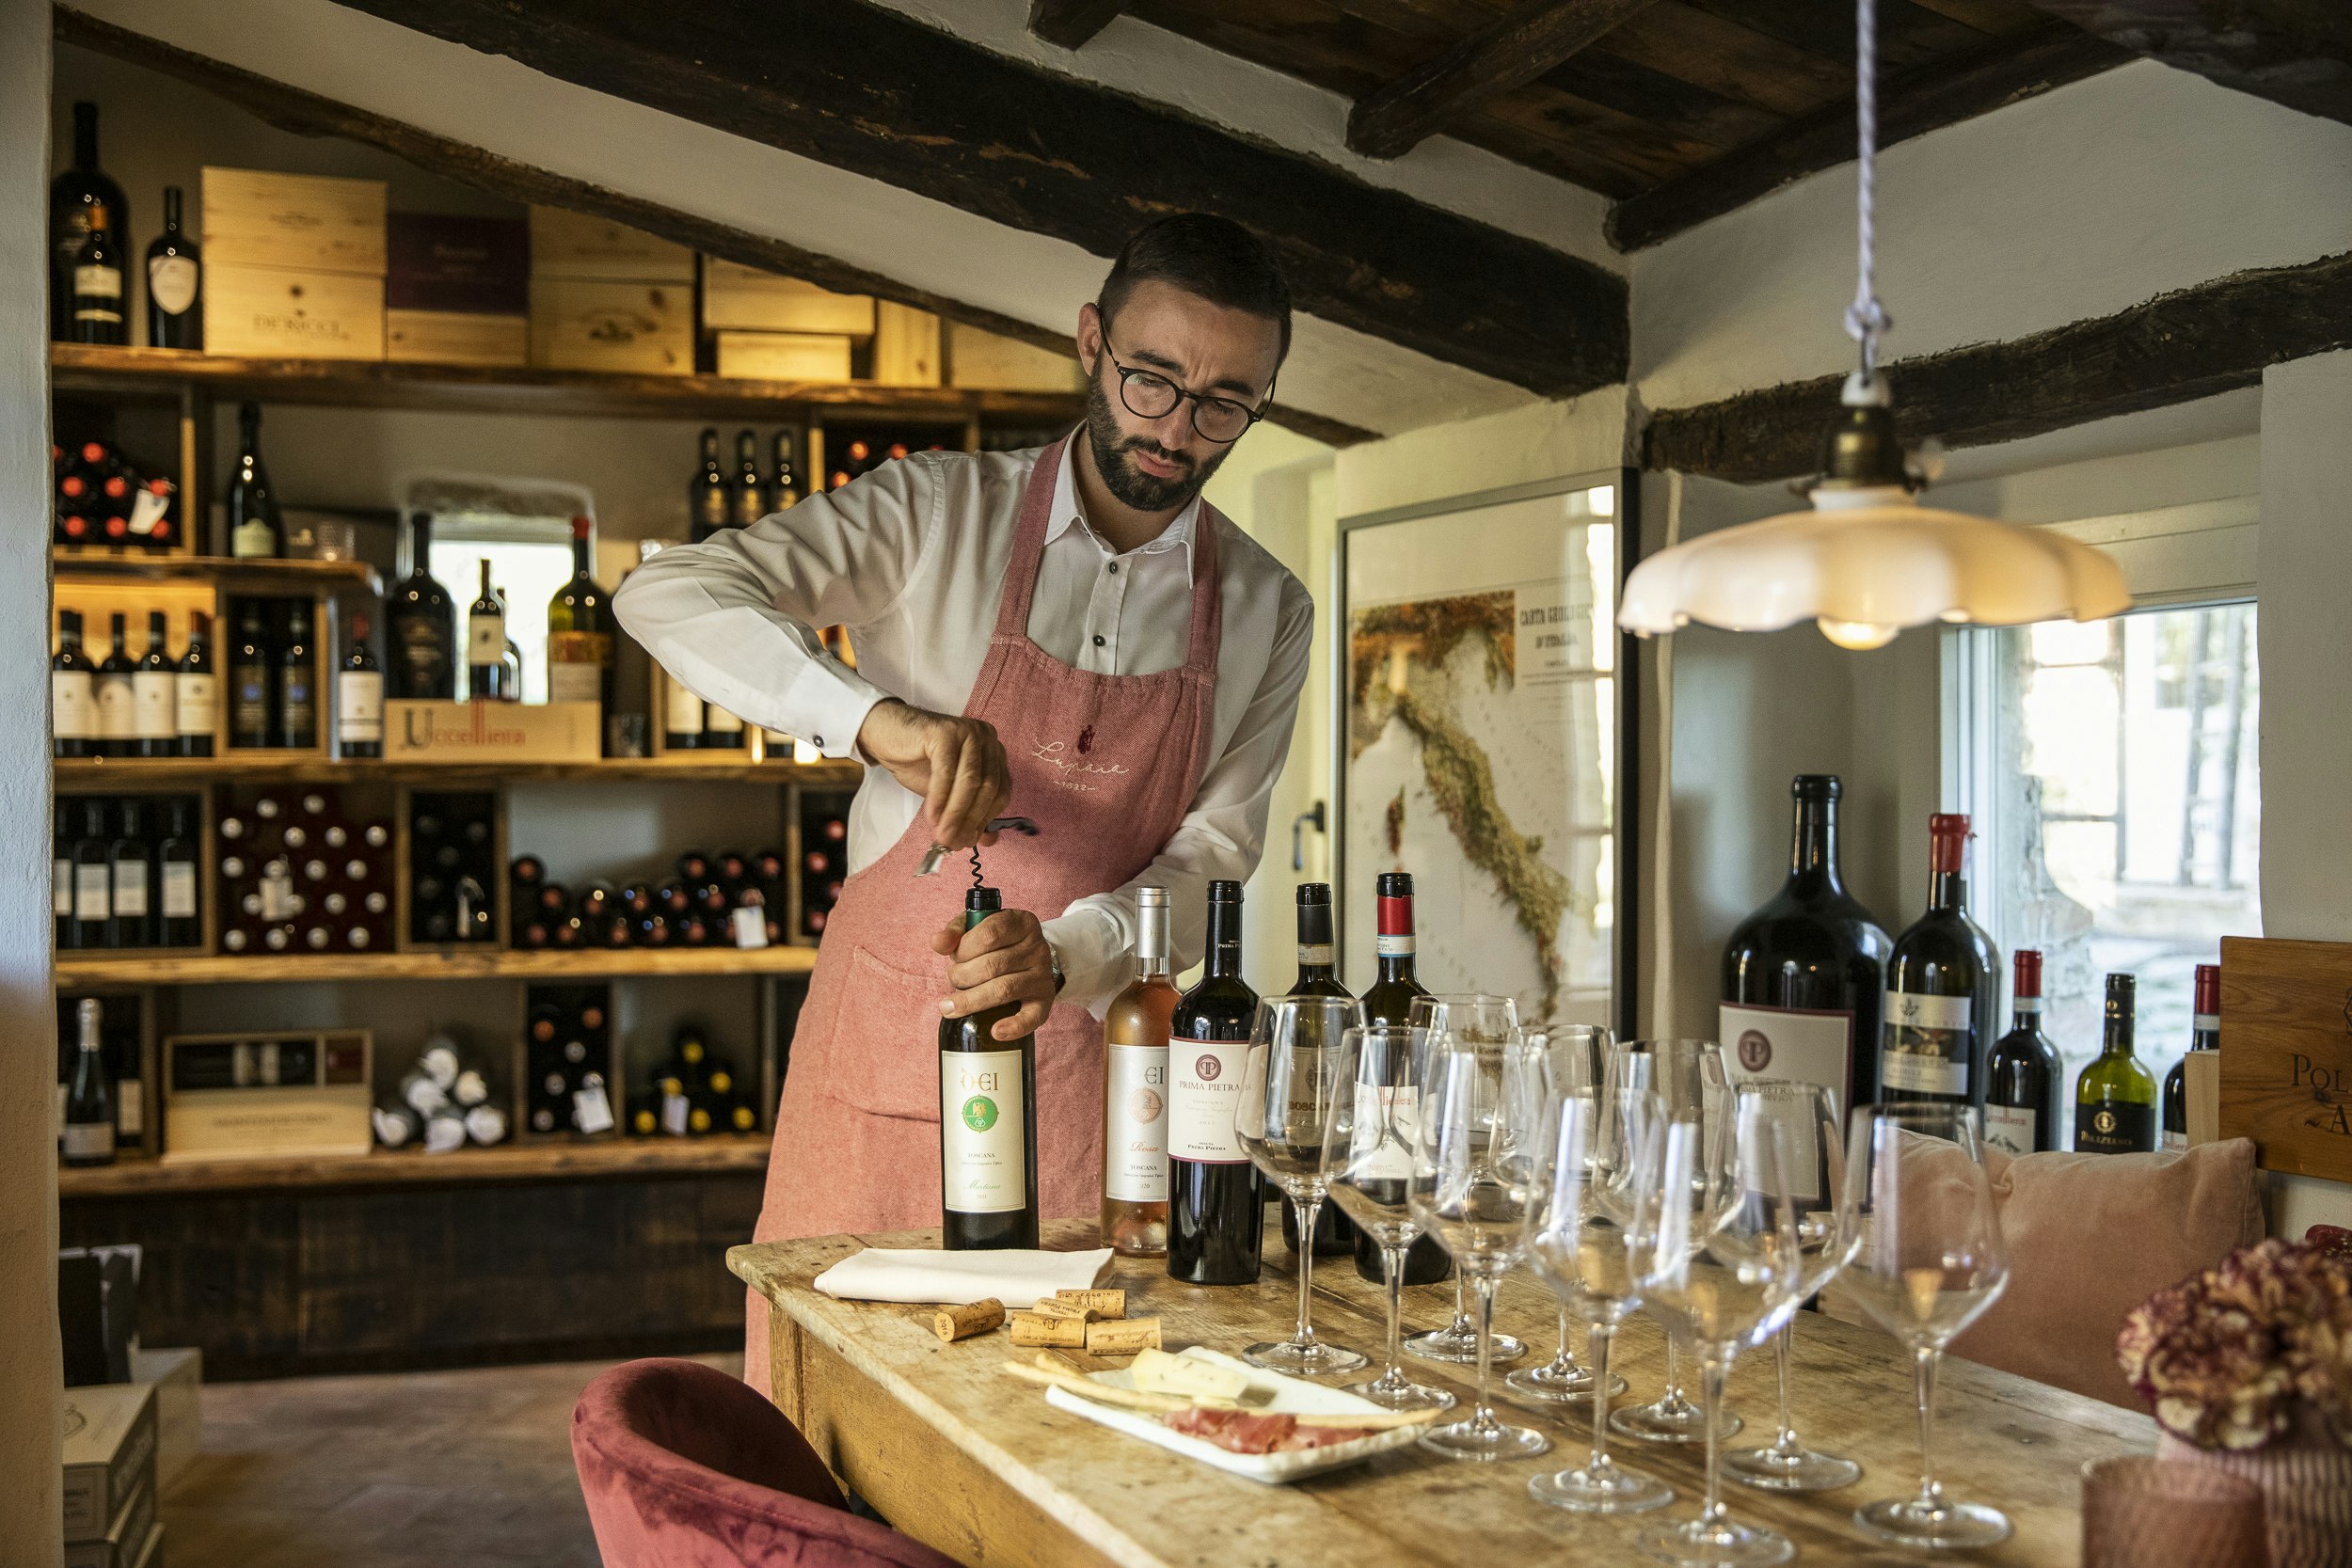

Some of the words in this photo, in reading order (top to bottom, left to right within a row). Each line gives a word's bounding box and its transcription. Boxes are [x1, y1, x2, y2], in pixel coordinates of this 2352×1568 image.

[1031, 736, 1130, 776] Lupaia
[1179, 1080, 1205, 1091] PRIMA
[1208, 1083, 1240, 1092] PIETRA
